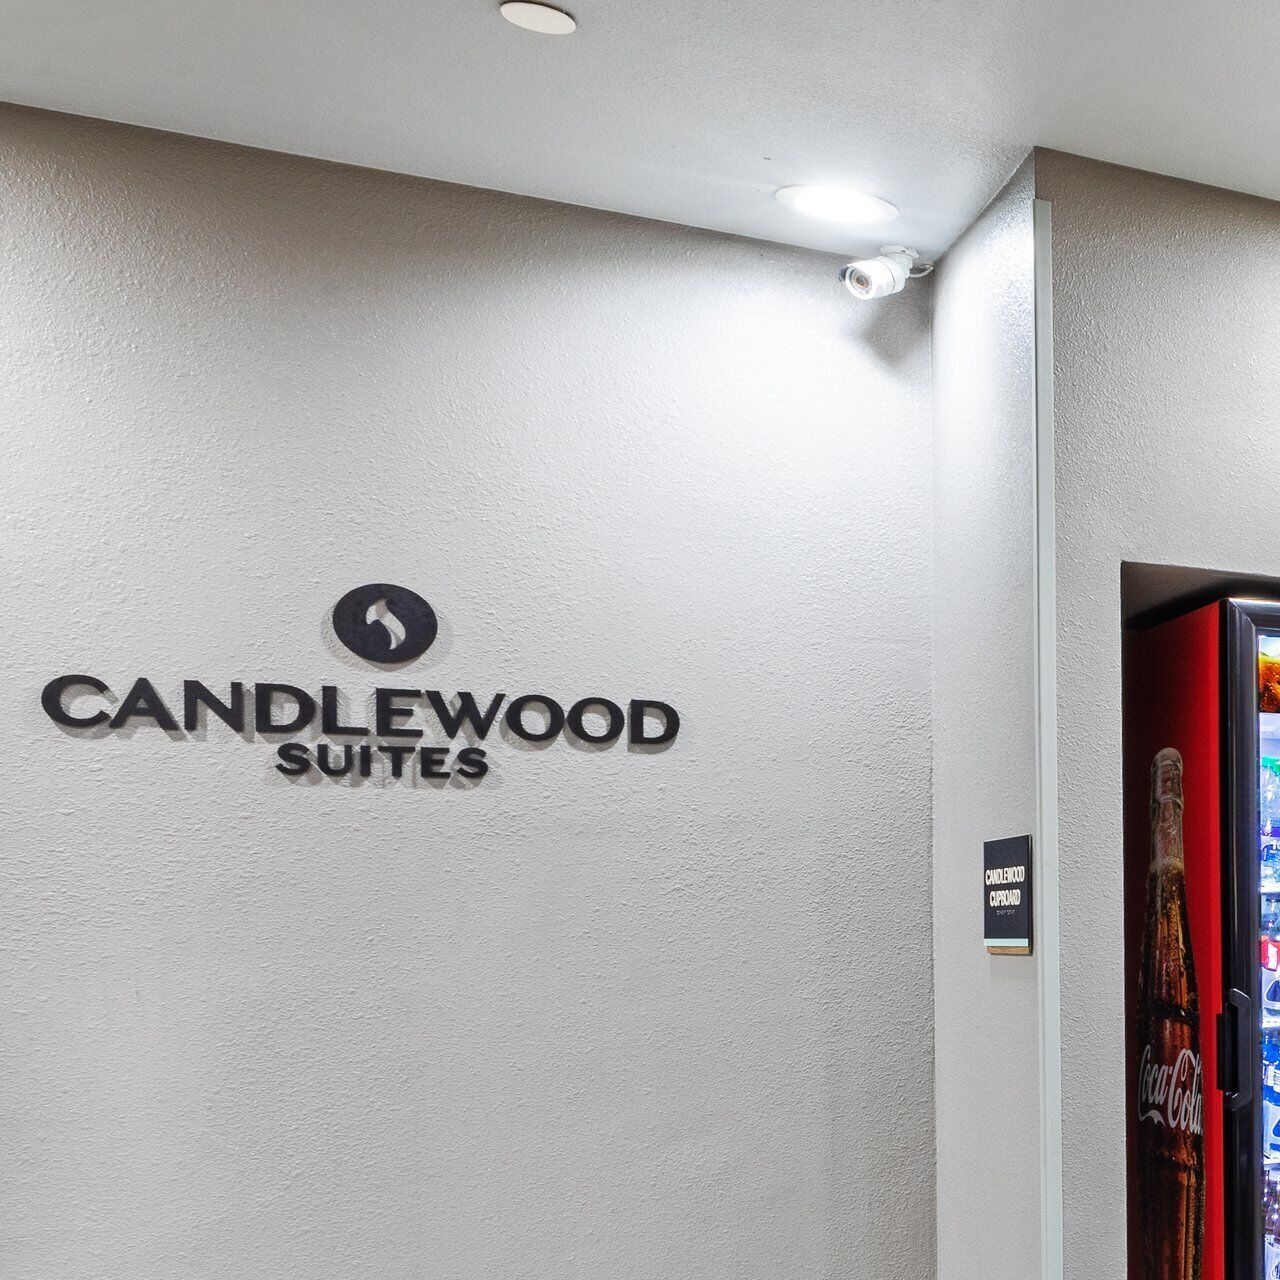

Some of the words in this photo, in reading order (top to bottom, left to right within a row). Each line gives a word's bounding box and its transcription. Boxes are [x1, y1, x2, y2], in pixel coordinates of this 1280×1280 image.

[41, 674, 680, 746] CANDLEWOOD
[275, 742, 489, 779] SUITES
[985, 866, 1025, 885] CANDLEWOOD
[989, 889, 1021, 907] CUPBOARD
